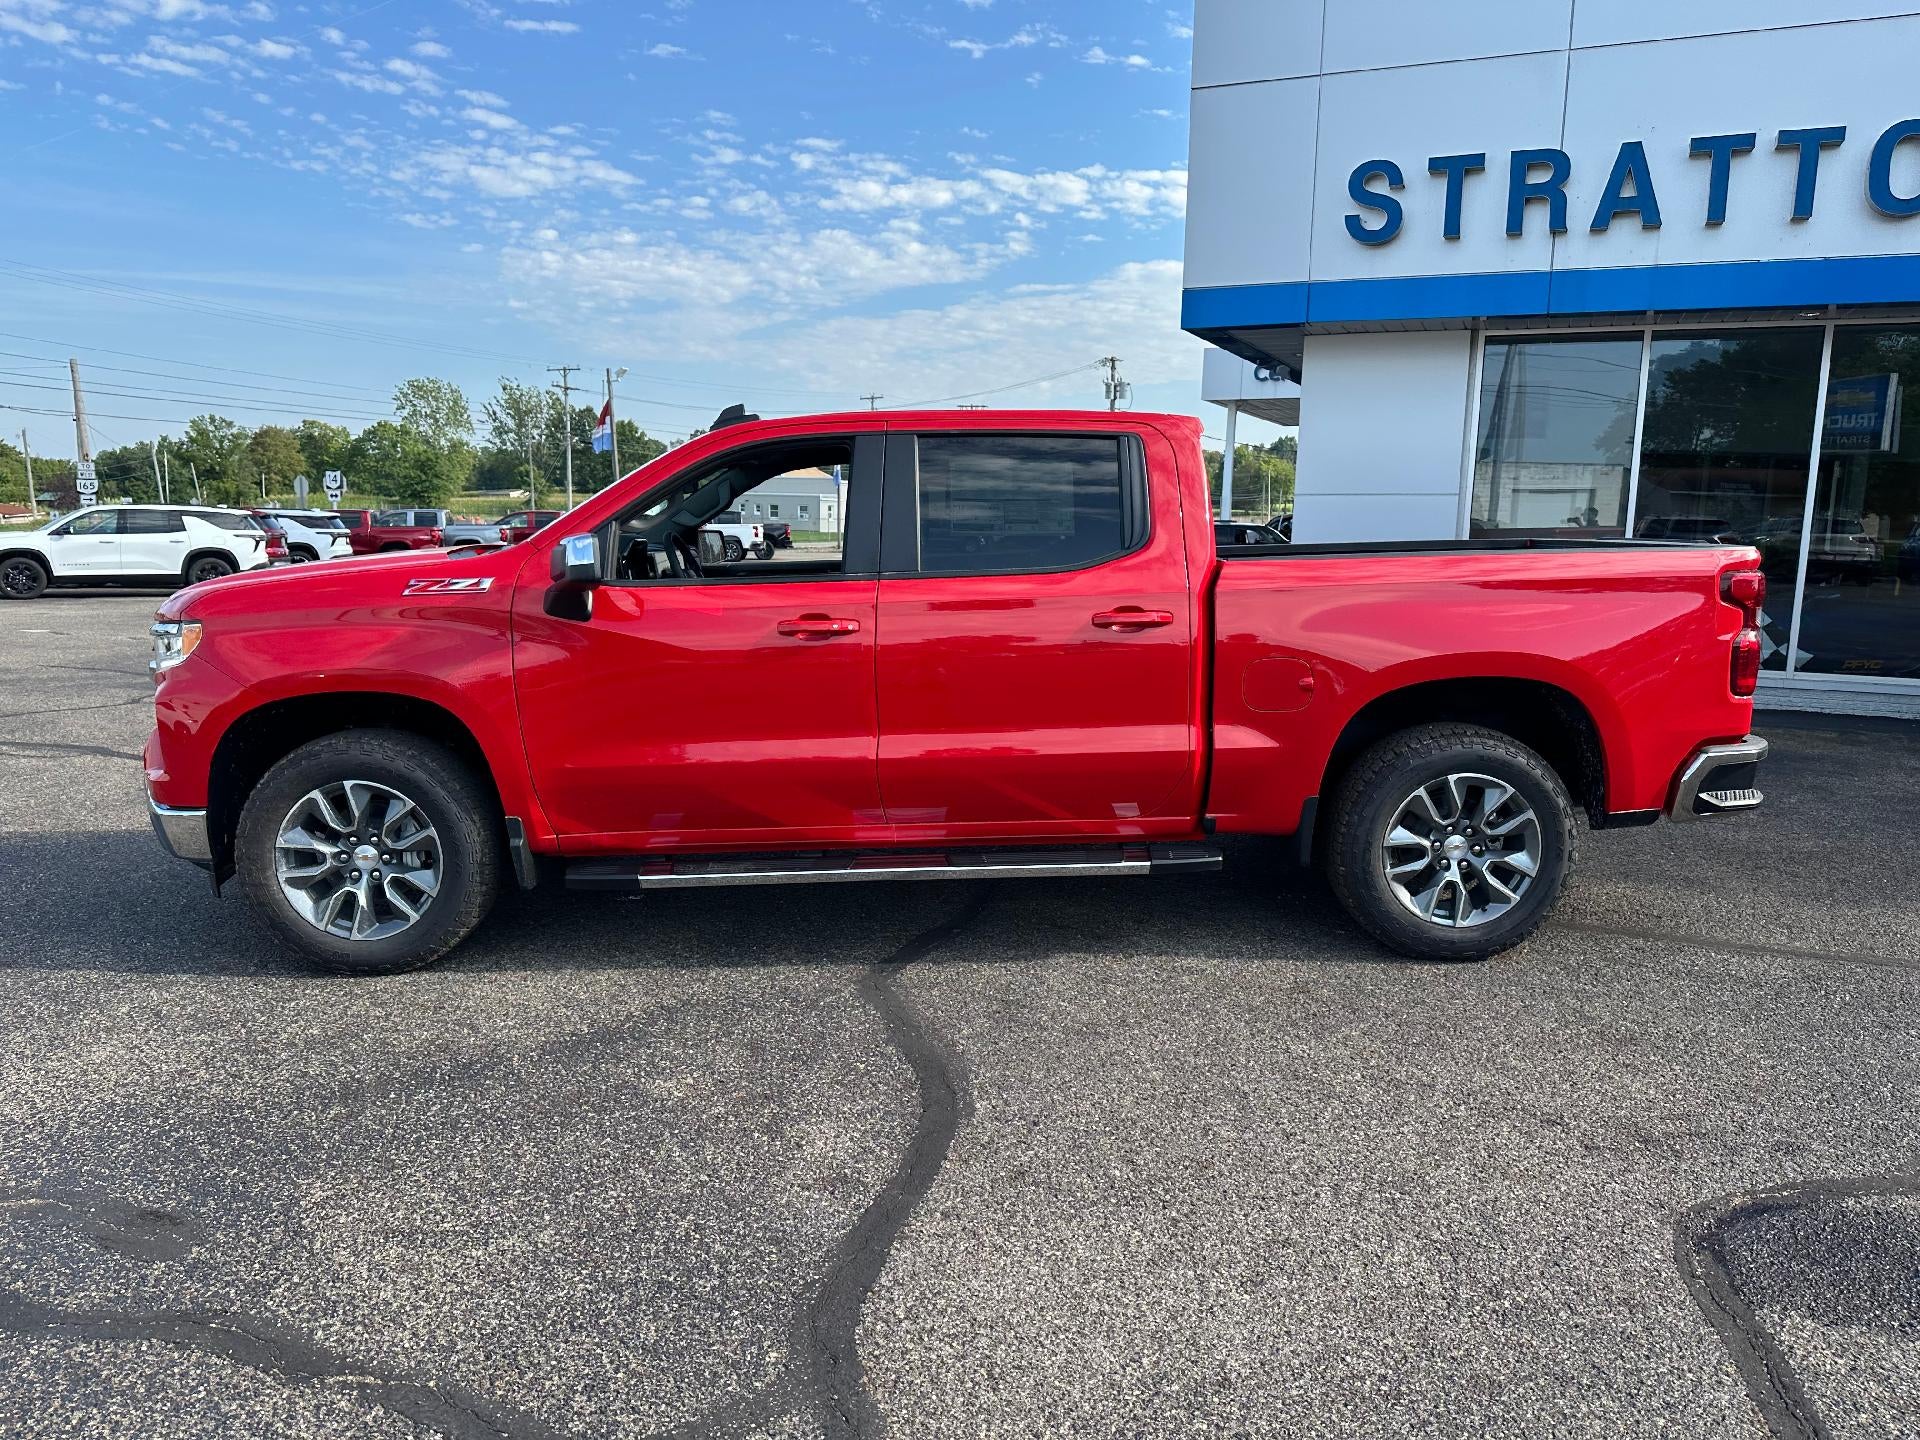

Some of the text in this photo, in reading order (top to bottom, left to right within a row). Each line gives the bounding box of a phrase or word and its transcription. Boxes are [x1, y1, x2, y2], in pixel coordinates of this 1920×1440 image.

[328, 474, 338, 484] 14
[79, 482, 95, 490] 165
[402, 577, 496, 595] Z71
